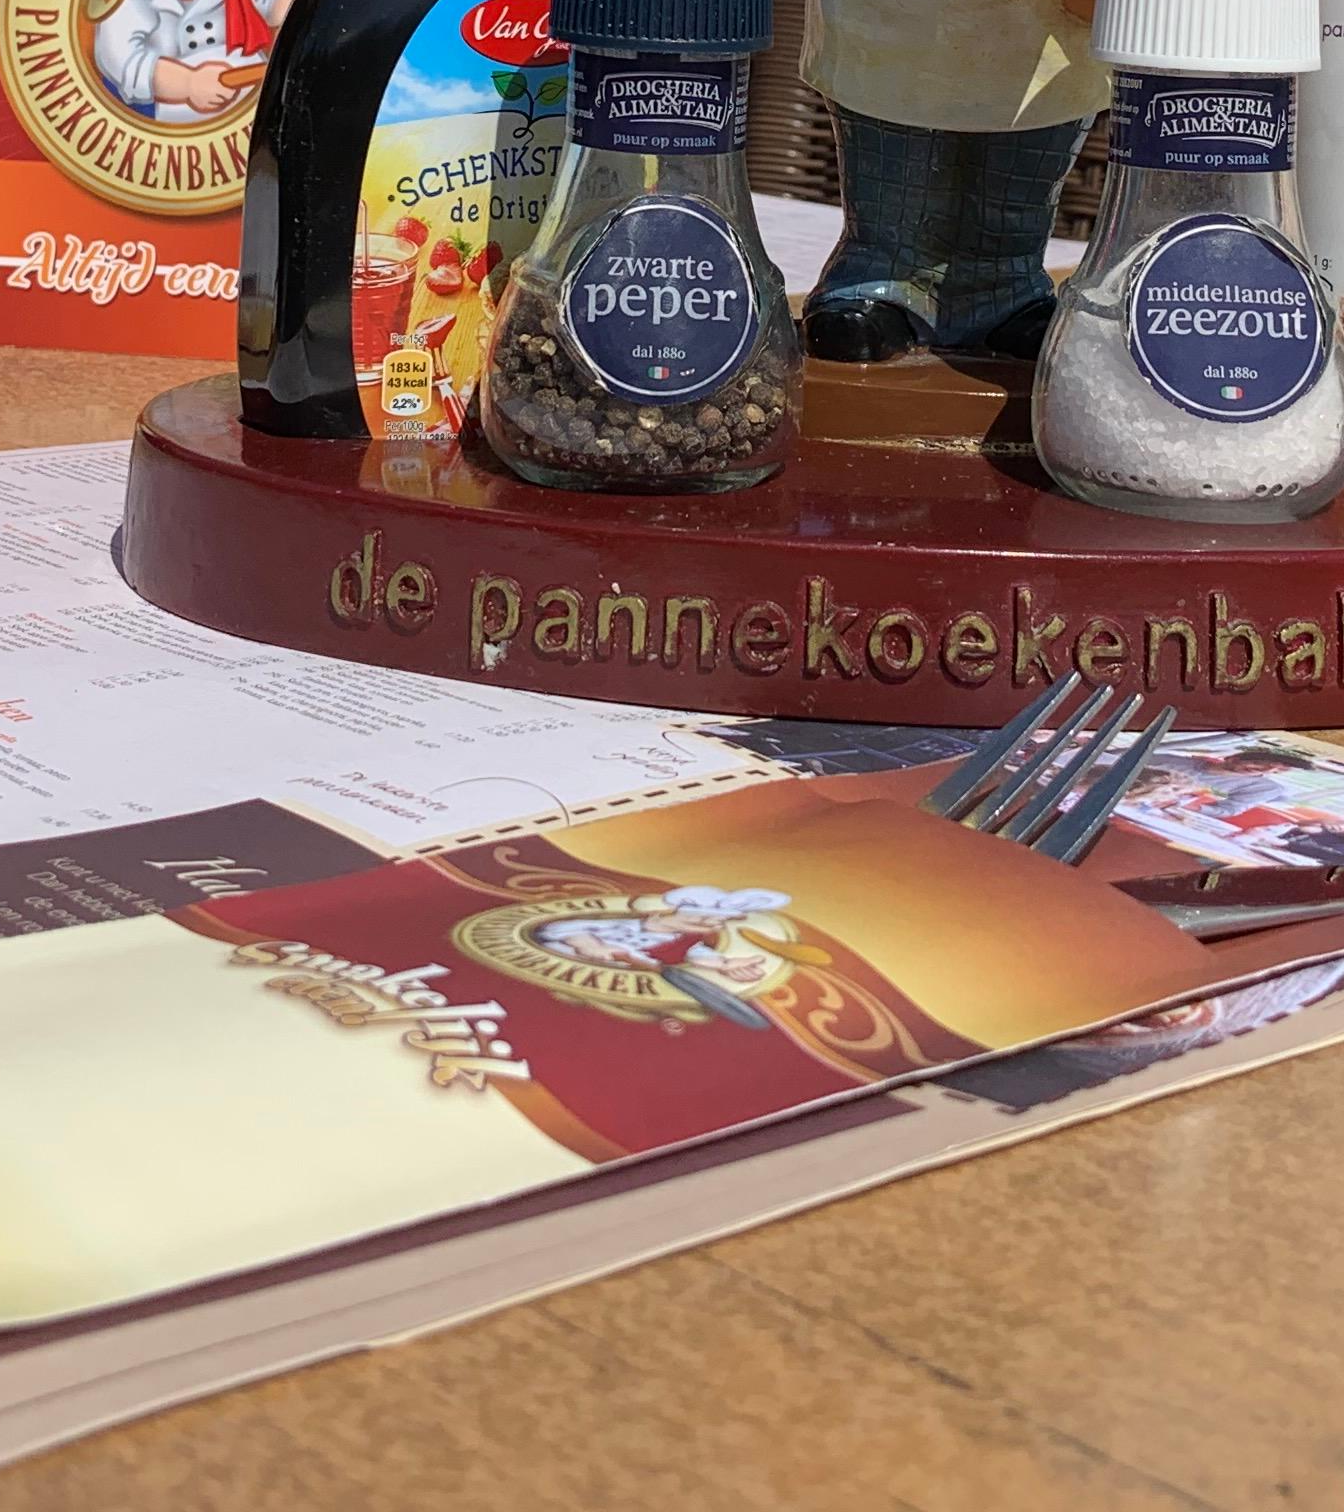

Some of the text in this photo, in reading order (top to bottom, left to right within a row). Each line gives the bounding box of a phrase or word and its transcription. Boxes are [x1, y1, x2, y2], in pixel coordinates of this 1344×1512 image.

[473, 6, 529, 40] Van
[611, 79, 721, 101] DROGHERIA
[661, 88, 683, 106] &
[608, 99, 723, 122] ALIMENTARI
[1162, 96, 1273, 118] DROGHERIA
[1214, 105, 1235, 123] &
[1159, 116, 1276, 139] ALIMENTARI
[613, 133, 717, 149] puur op smaak
[1165, 151, 1270, 167] puur op smaak
[450, 197, 480, 223] de
[7, 231, 241, 305] Altijd een
[607, 255, 714, 280] zwarte
[583, 283, 738, 325] peper
[1146, 281, 1307, 306] middellandse
[1147, 307, 1309, 340] zeezout
[632, 345, 687, 359] dal 1880
[390, 362, 426, 373] 183 kJ
[1203, 366, 1258, 379] dal 1880
[387, 377, 427, 388] 43 kcal
[329, 528, 435, 625] de
